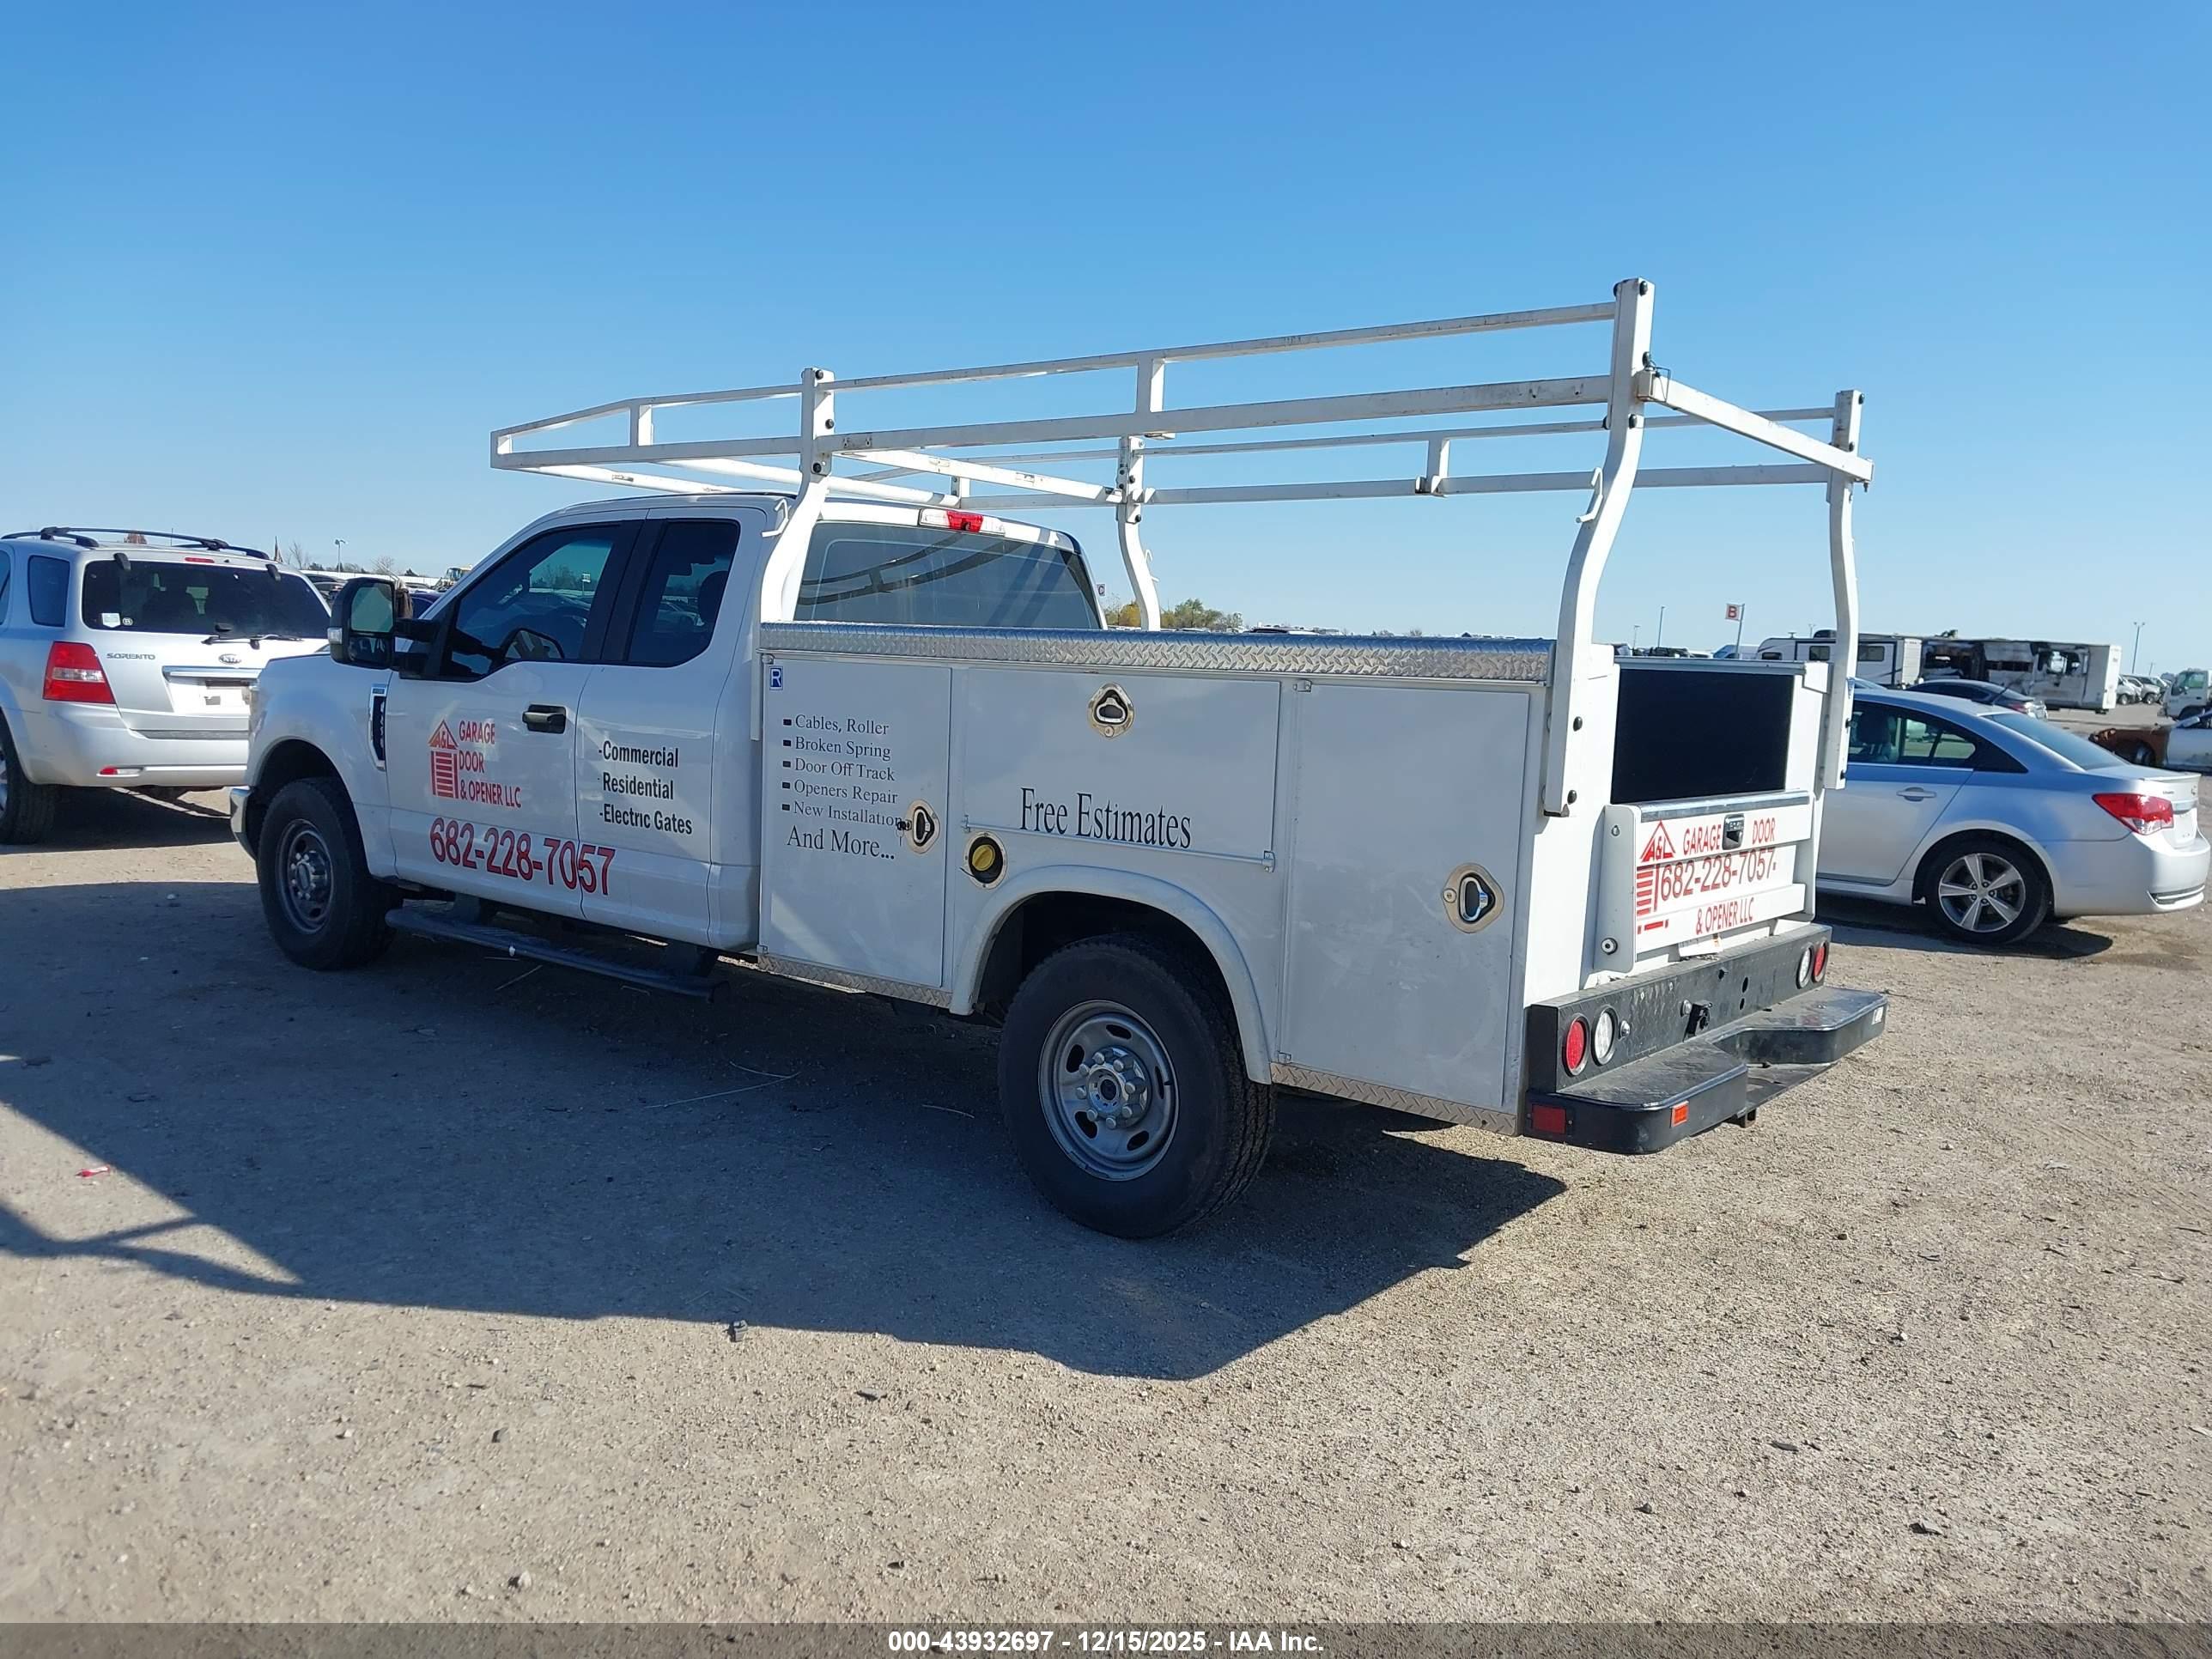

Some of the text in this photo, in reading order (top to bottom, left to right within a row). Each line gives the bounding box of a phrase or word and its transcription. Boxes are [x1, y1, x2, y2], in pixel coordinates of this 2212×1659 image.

[1728, 605, 1737, 618] B
[770, 668, 782, 687] R
[459, 720, 495, 744] GARAGE
[795, 714, 889, 734] Cables, Roller
[433, 730, 458, 750] A&L
[795, 737, 890, 761] Broken Spring
[459, 750, 485, 773] DOOR
[795, 758, 895, 781] Door Off Track
[459, 779, 521, 808] & OPENER LLC
[794, 780, 898, 805] Openers Repair
[794, 801, 823, 815] New
[1019, 787, 1191, 848] Free Estimates
[653, 810, 692, 835] Gates
[787, 825, 894, 859] And More...
[1683, 817, 1776, 855] GARAGE DOOR
[429, 817, 616, 896] 682-228-7057
[1641, 836, 1674, 862] A&L
[1695, 897, 1754, 935] & OPENER LLC
